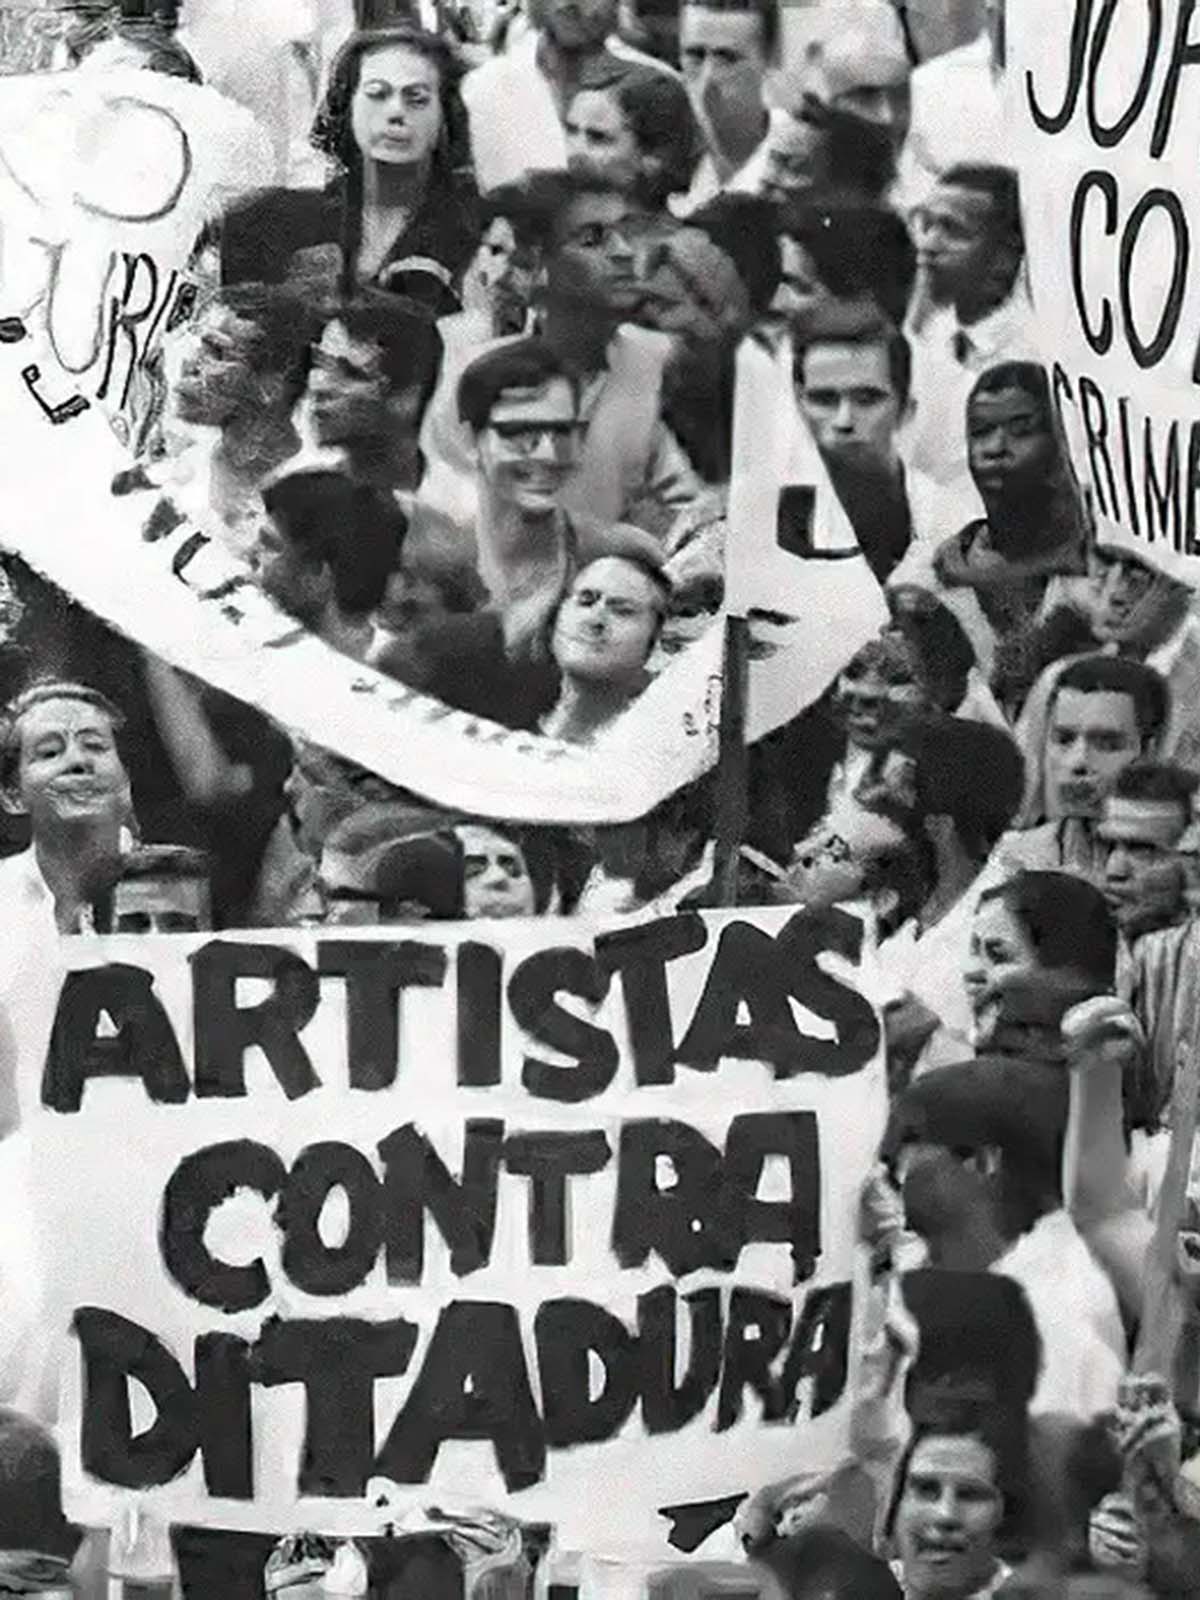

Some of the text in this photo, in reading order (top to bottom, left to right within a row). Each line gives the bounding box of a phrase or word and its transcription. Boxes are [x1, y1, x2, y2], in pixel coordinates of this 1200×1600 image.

[41, 904, 882, 1113] ARTISTAS
[159, 1111, 822, 1315] CONTRA
[68, 1283, 855, 1500] DITADURA
